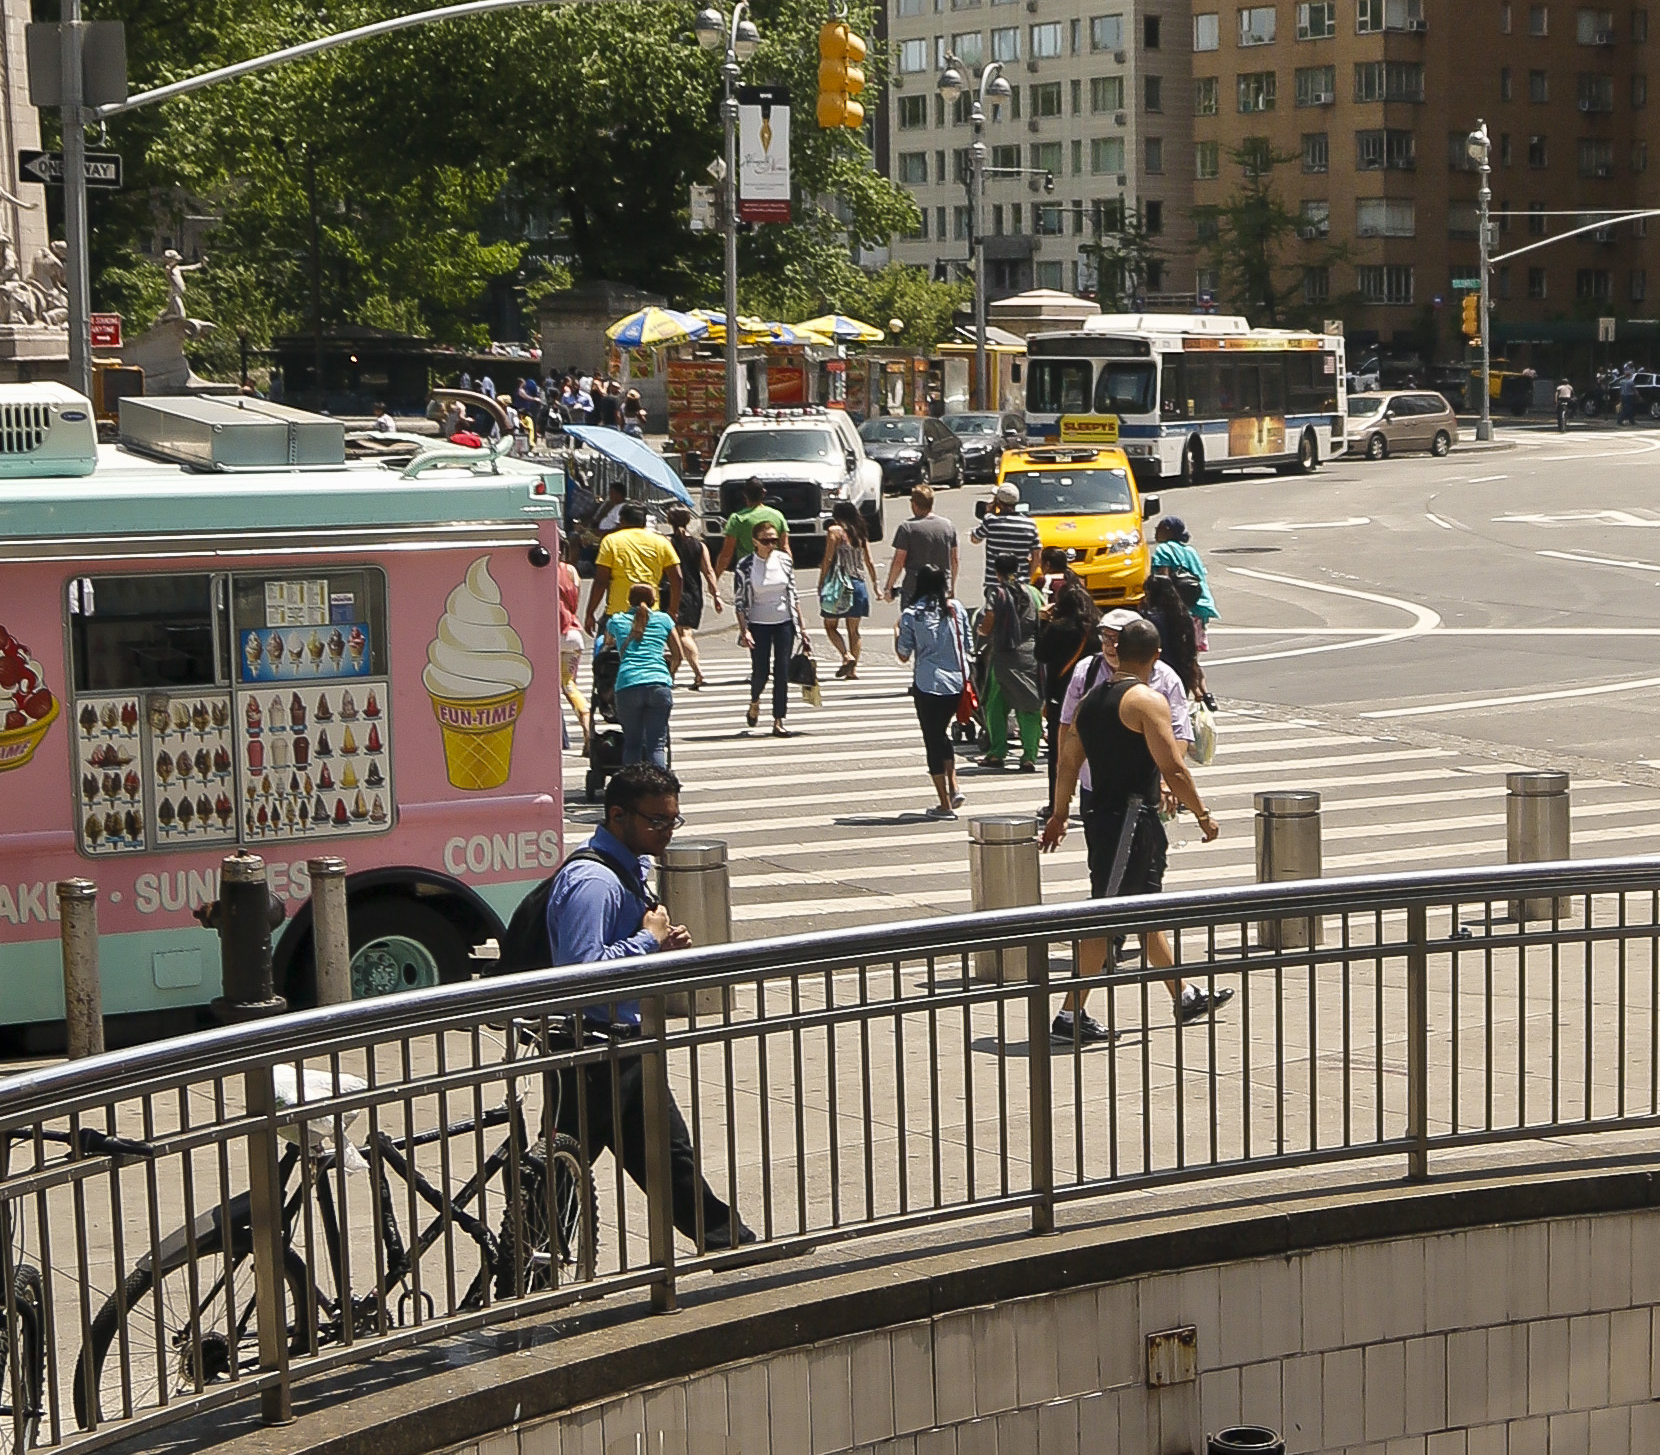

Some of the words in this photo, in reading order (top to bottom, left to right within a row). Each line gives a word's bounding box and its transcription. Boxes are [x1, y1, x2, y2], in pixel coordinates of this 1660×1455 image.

[439, 702, 517, 726] FUN-TIME
[443, 829, 560, 876] CONES
[134, 860, 312, 914] SUNES
